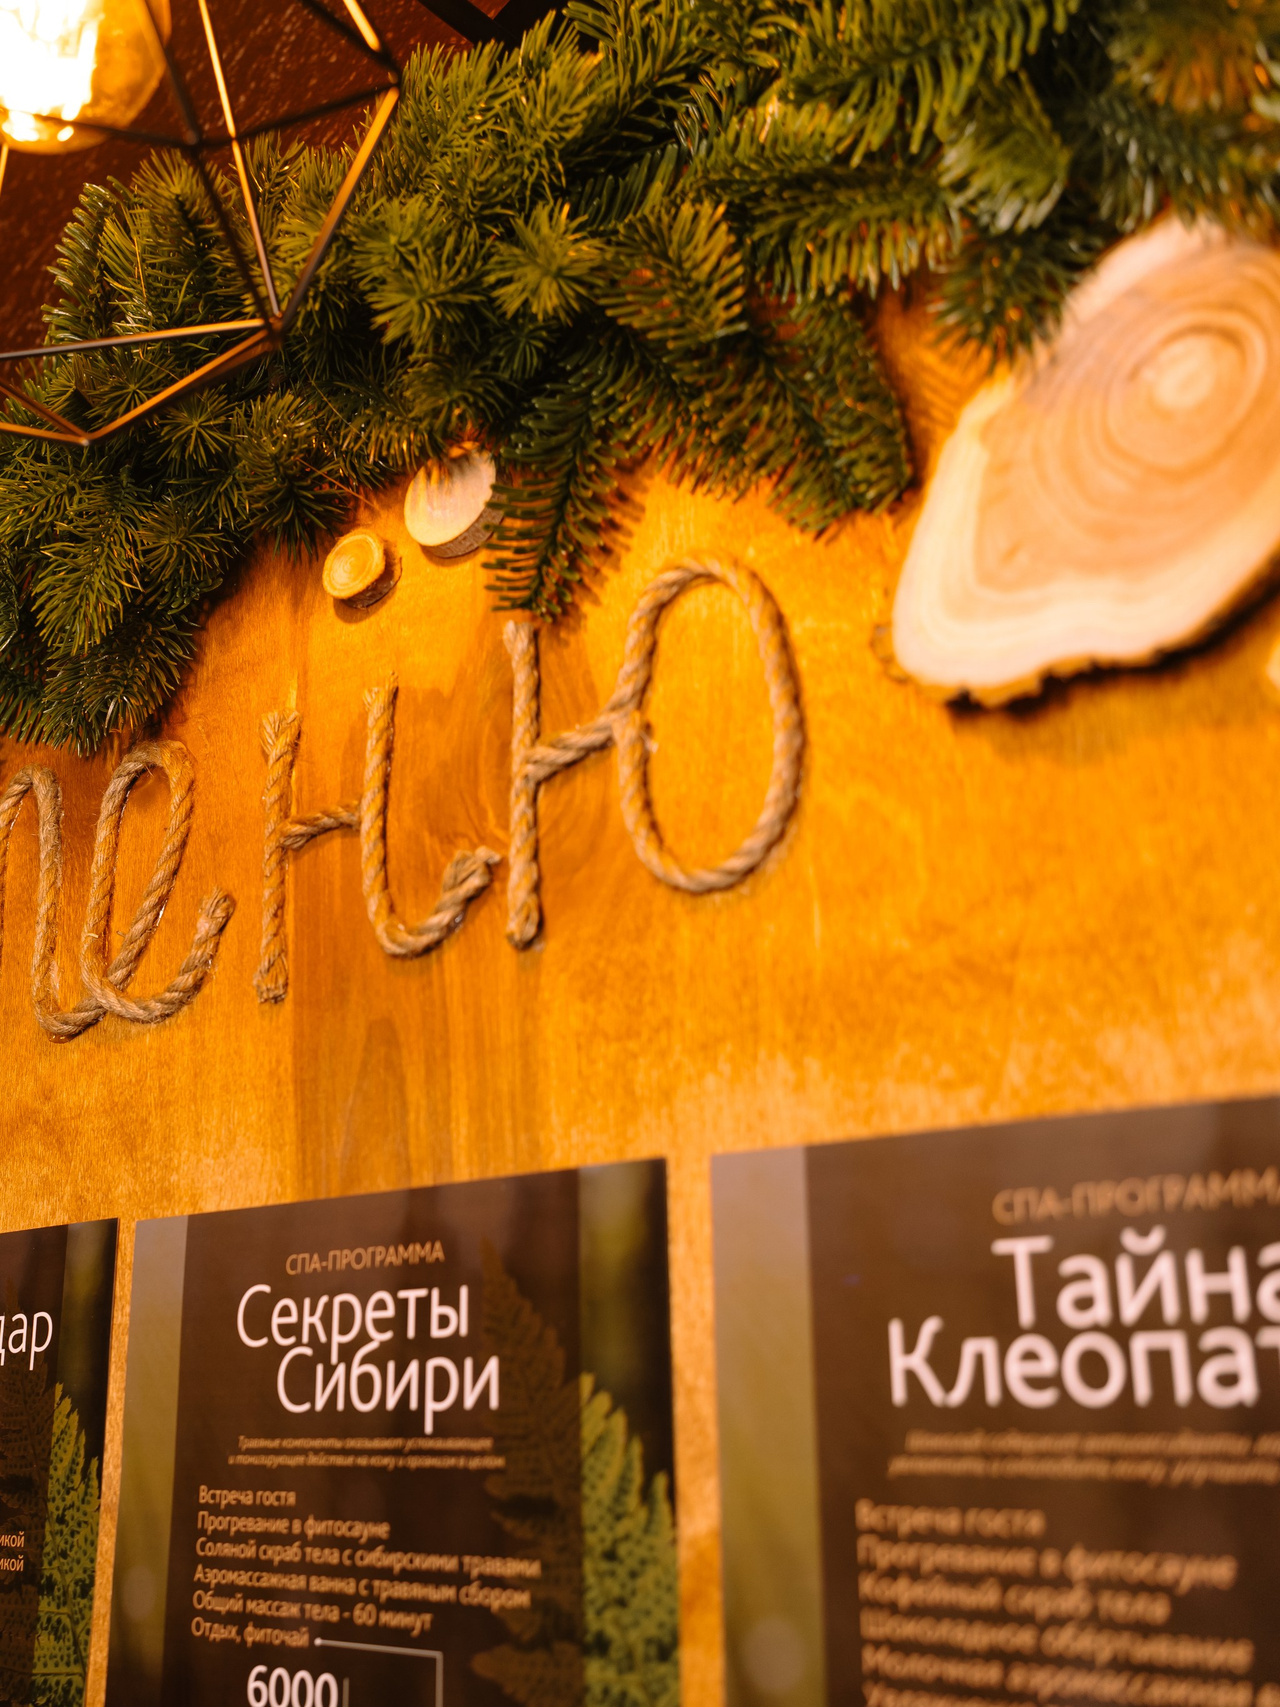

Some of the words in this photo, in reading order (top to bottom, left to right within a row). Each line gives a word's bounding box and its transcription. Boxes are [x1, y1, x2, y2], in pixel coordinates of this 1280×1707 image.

[991, 1165, 1280, 1226] СПА-ПРОГРАММ
[286, 1240, 445, 1276] СПА-ПРОГРАММА
[236, 1284, 469, 1365] Секреты
[277, 1338, 500, 1435] Сибири
[198, 1485, 253, 1510] Встреча
[255, 1490, 296, 1506] гостя
[855, 1498, 963, 1539] Встреча
[964, 1507, 1046, 1538] гостя
[197, 1511, 290, 1537] Прогревание
[291, 1518, 302, 1535] в
[303, 1514, 391, 1545] фитосауне
[196, 1536, 256, 1560] Соляной
[258, 1540, 302, 1567] скраб
[303, 1546, 340, 1566] тела
[342, 1548, 353, 1566] с
[354, 1544, 459, 1576] сибирскими
[460, 1554, 542, 1580] травами
[856, 1533, 1038, 1575] Прогревание
[1039, 1548, 1061, 1579] в
[1063, 1543, 1238, 1596] фитосауне
[193, 1563, 307, 1589] Аэромассажная
[308, 1574, 357, 1596] ванна
[358, 1578, 370, 1597] с
[370, 1579, 458, 1605] травяным
[458, 1580, 532, 1614] сбором
[858, 1570, 1002, 1614] Кофейный
[1004, 1581, 1092, 1623] скраб
[1097, 1589, 1170, 1625] тела
[190, 1616, 241, 1644] Отдых,
[243, 1621, 310, 1649] фиточай
[192, 1589, 243, 1615] Общий
[245, 1599, 302, 1619] массаж
[303, 1602, 341, 1624] тела
[352, 1602, 378, 1627] 60
[378, 1609, 435, 1638] минут
[860, 1606, 1039, 1655] Шоколадное
[247, 1664, 339, 1707] 6000
[861, 1643, 1004, 1687] Молочная
